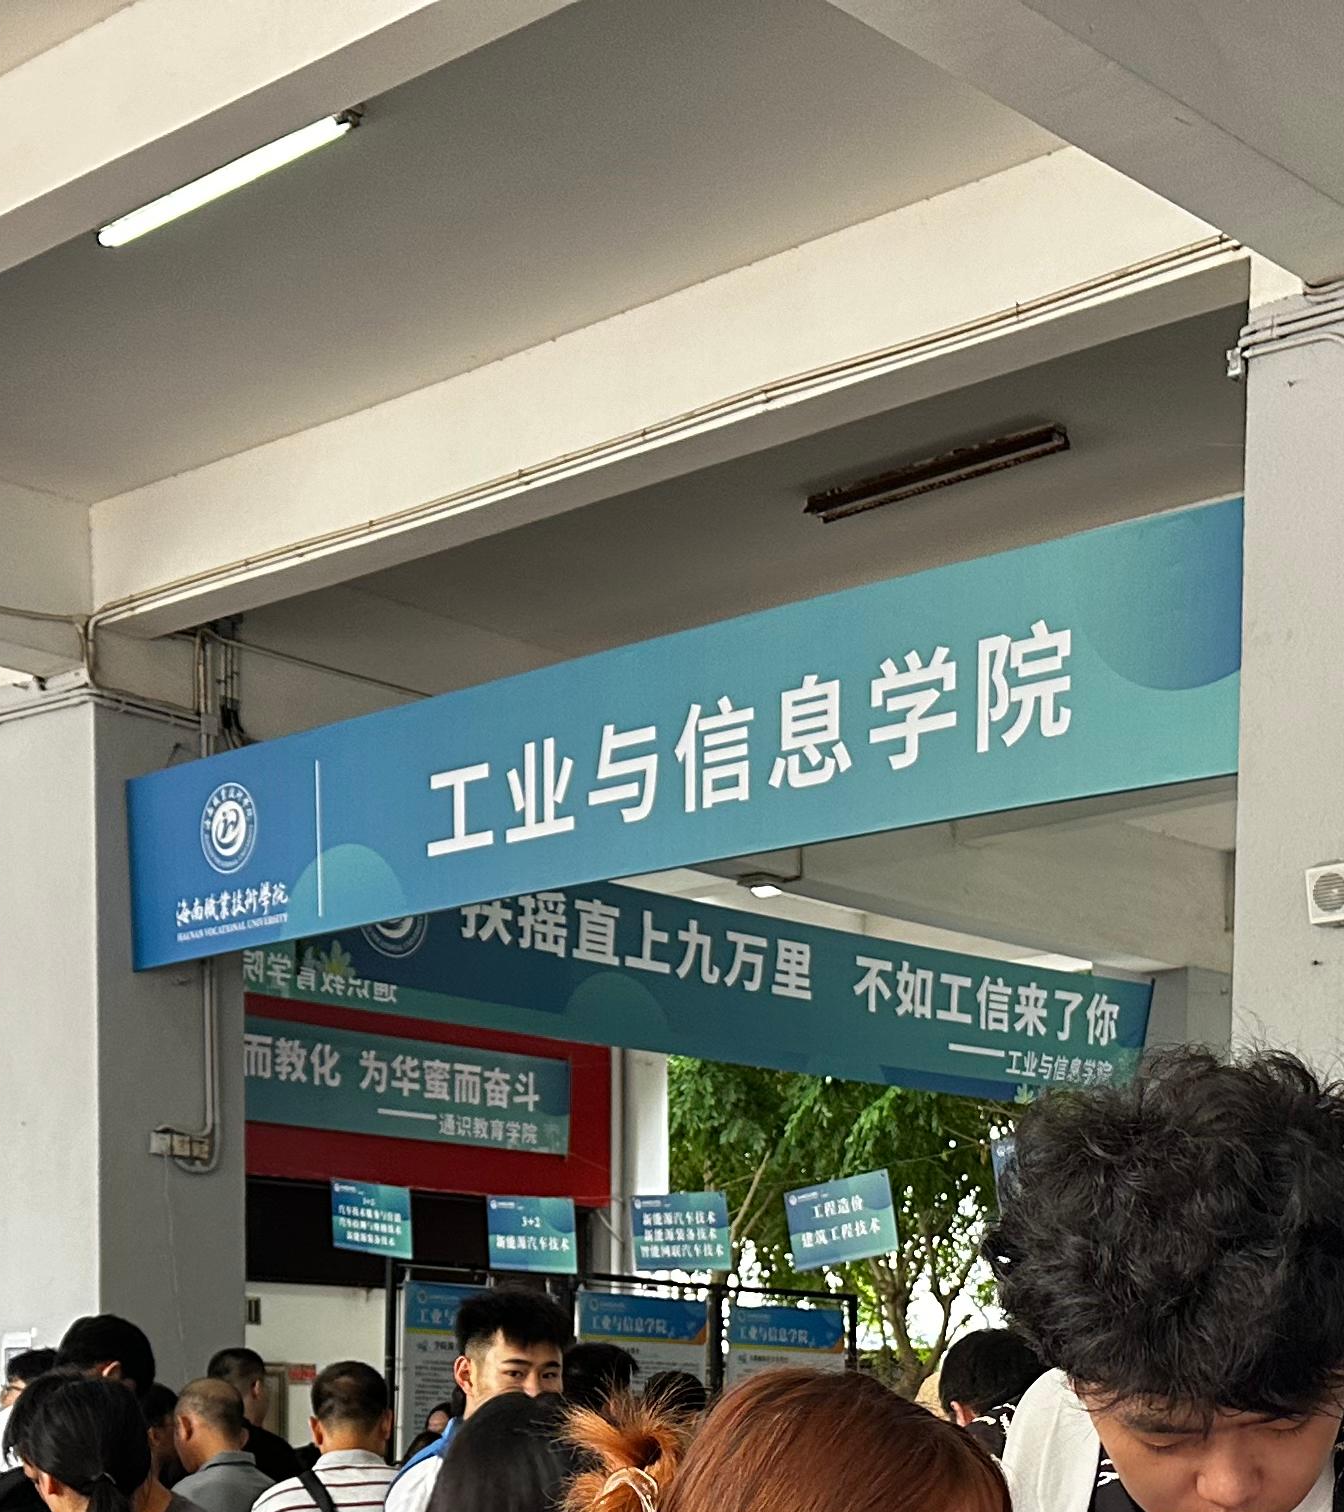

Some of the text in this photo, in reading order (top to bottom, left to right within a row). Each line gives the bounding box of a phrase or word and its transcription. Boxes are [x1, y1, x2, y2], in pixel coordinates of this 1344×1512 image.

[426, 619, 1074, 858] 工业与信息学院
[460, 891, 1120, 1047] 扶摇直上九万里 不如工信来了你
[496, 1234, 570, 1253] 新能源汽车技术
